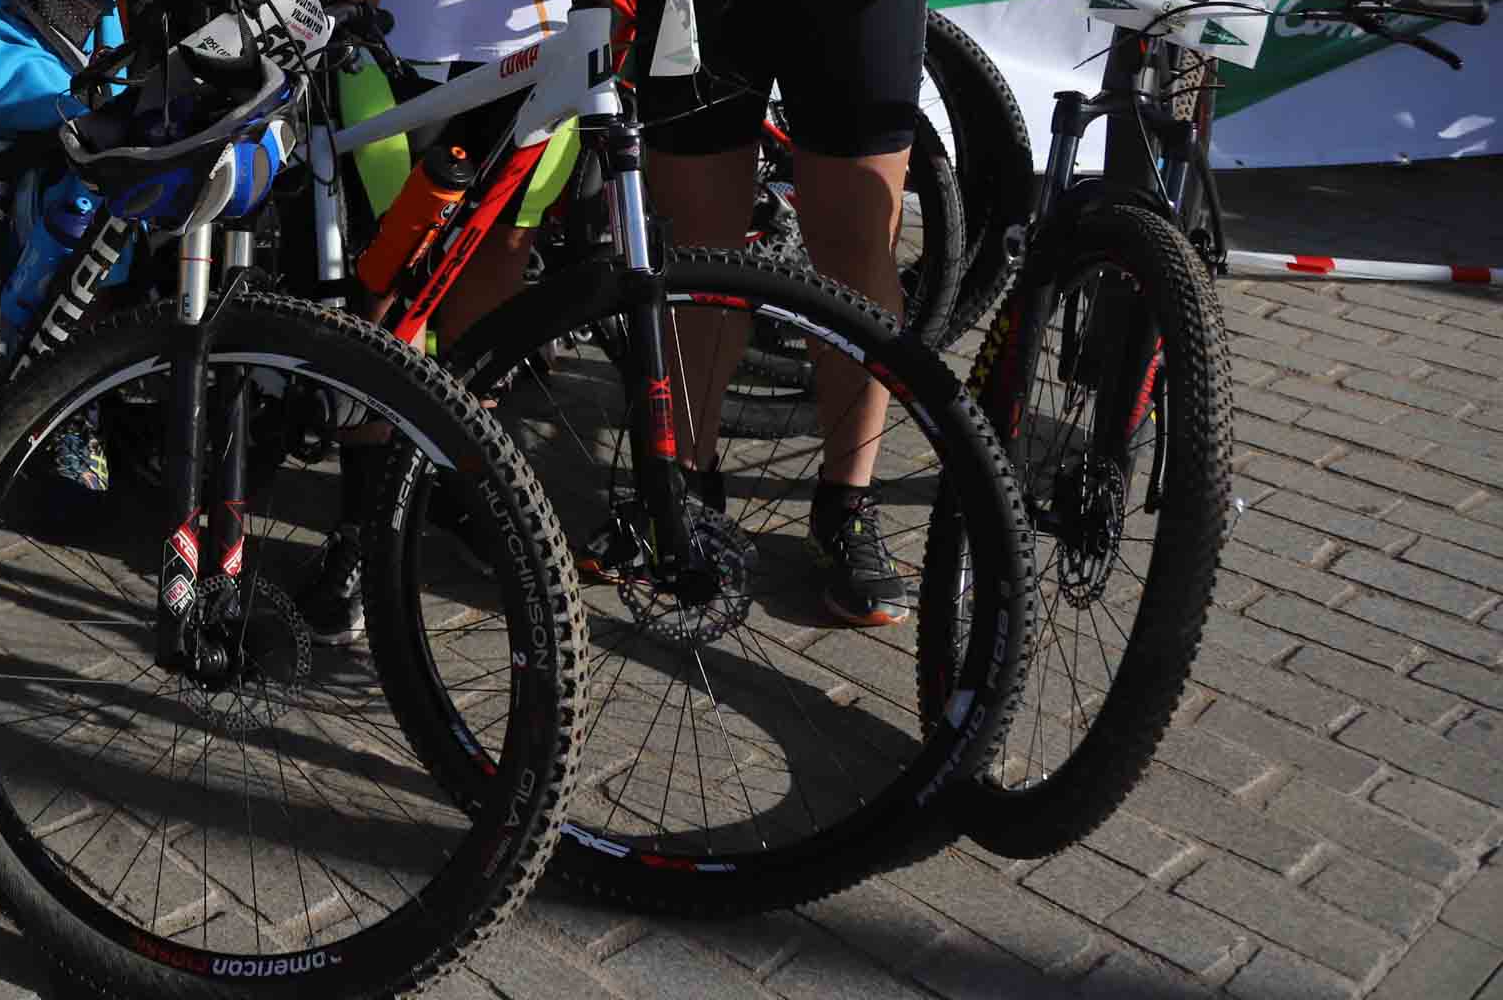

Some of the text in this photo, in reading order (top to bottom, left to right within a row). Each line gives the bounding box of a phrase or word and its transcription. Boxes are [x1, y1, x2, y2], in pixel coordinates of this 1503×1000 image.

[291, 7, 323, 36] VILLAMAYOR
[480, 479, 551, 672] HUTCHINSON
[211, 951, 327, 977] american
